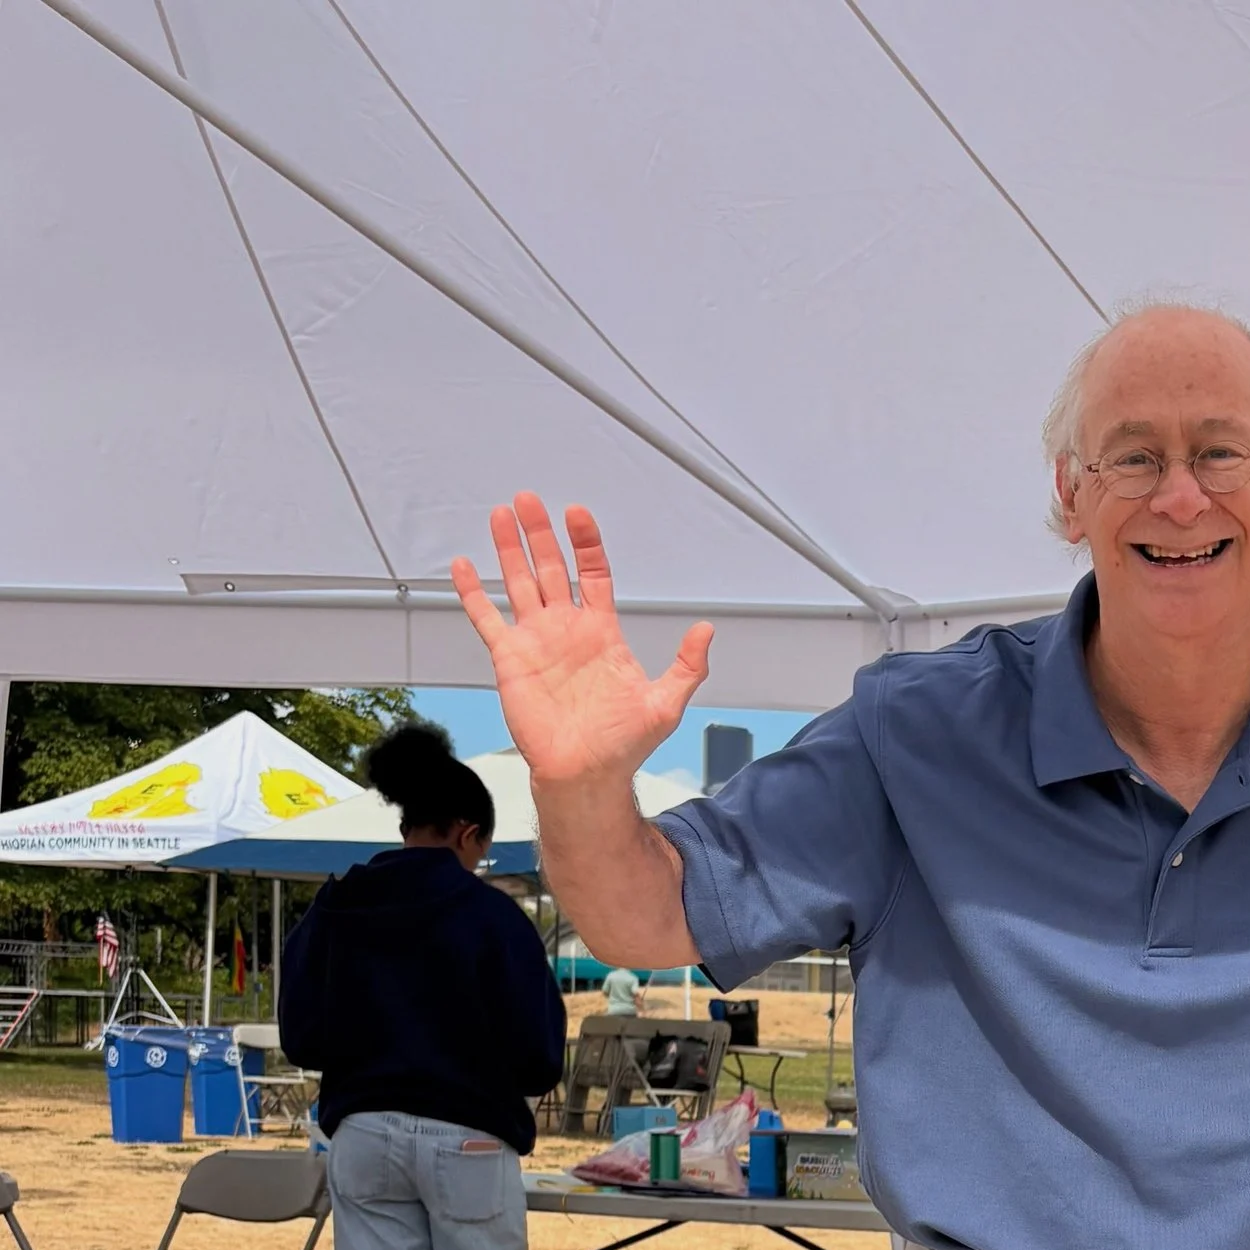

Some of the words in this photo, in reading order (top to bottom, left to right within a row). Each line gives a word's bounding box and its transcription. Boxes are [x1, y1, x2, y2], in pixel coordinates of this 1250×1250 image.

[48, 837, 114, 849] COMMUNITY
[117, 837, 129, 849] IN
[132, 837, 181, 849] SEATTLE
